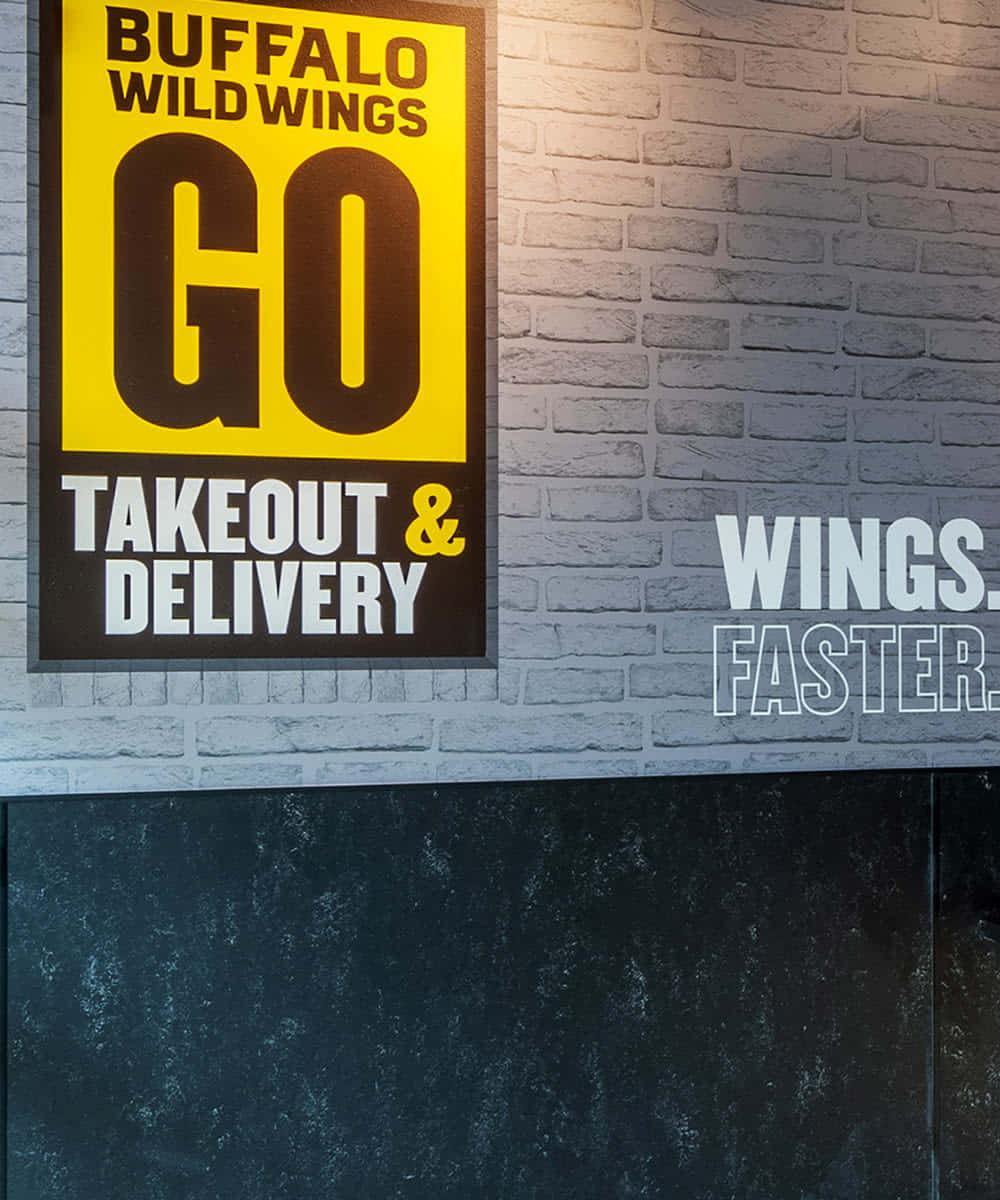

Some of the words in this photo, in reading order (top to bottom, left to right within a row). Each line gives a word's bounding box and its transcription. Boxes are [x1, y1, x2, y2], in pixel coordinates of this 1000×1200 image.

[105, 5, 428, 90] BUFFALO
[107, 69, 248, 122] WILD
[255, 83, 428, 138] WINGS
[114, 132, 420, 436] GO
[61, 475, 388, 555] TAKEOUT
[405, 483, 466, 557] &
[105, 559, 427, 636] DELIVERY
